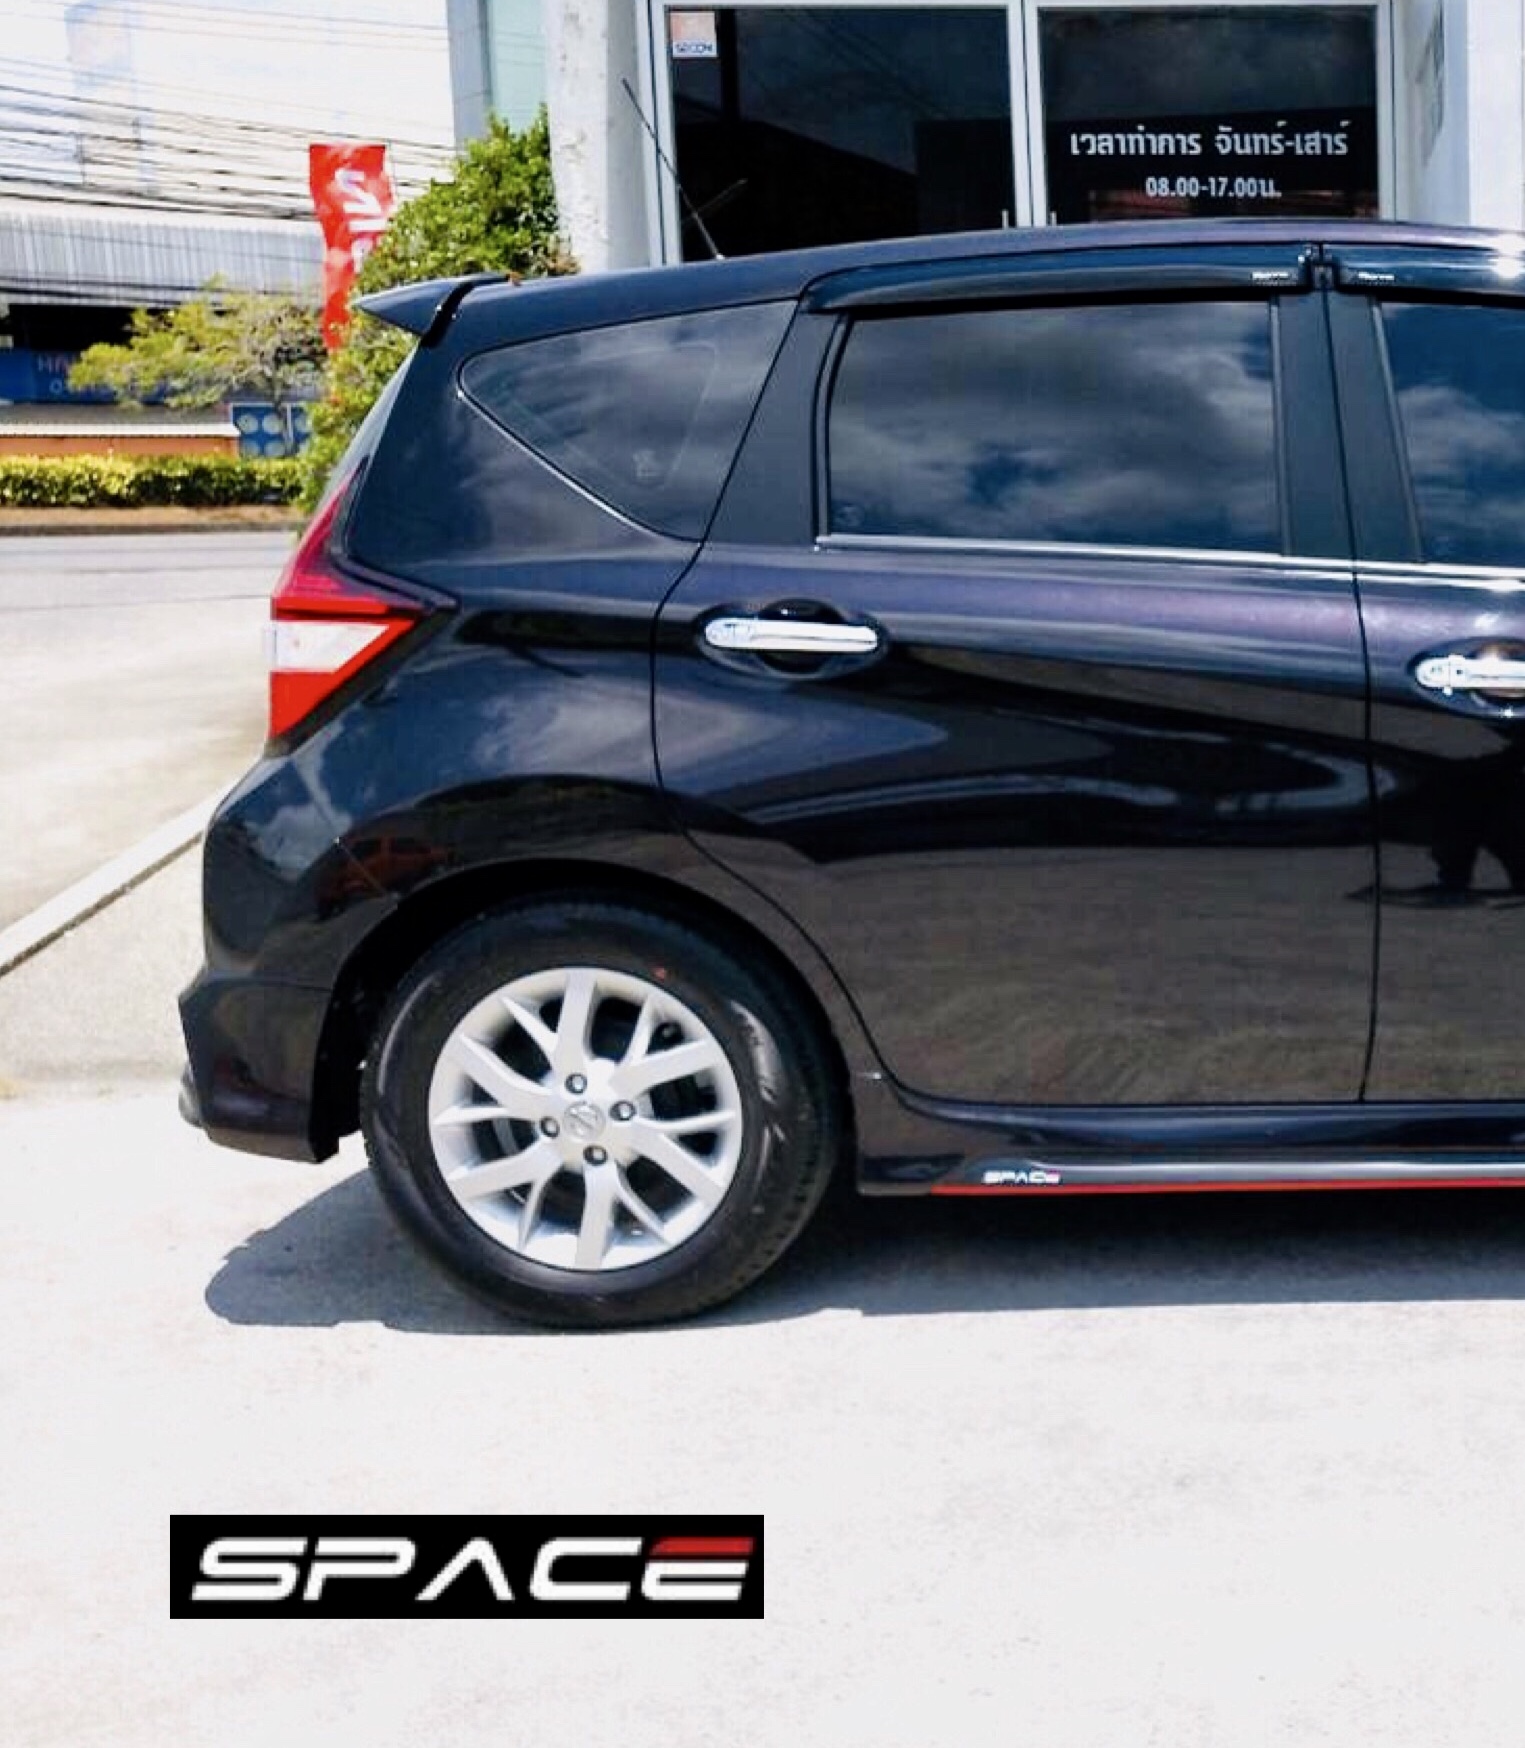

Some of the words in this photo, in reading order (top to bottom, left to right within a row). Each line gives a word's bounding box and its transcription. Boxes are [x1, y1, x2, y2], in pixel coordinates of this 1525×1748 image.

[1070, 124, 1202, 155] เวลาทำการ
[1214, 120, 1351, 155] จันทร์-เสาร์
[1145, 177, 1282, 198] 08.00-17.00น.
